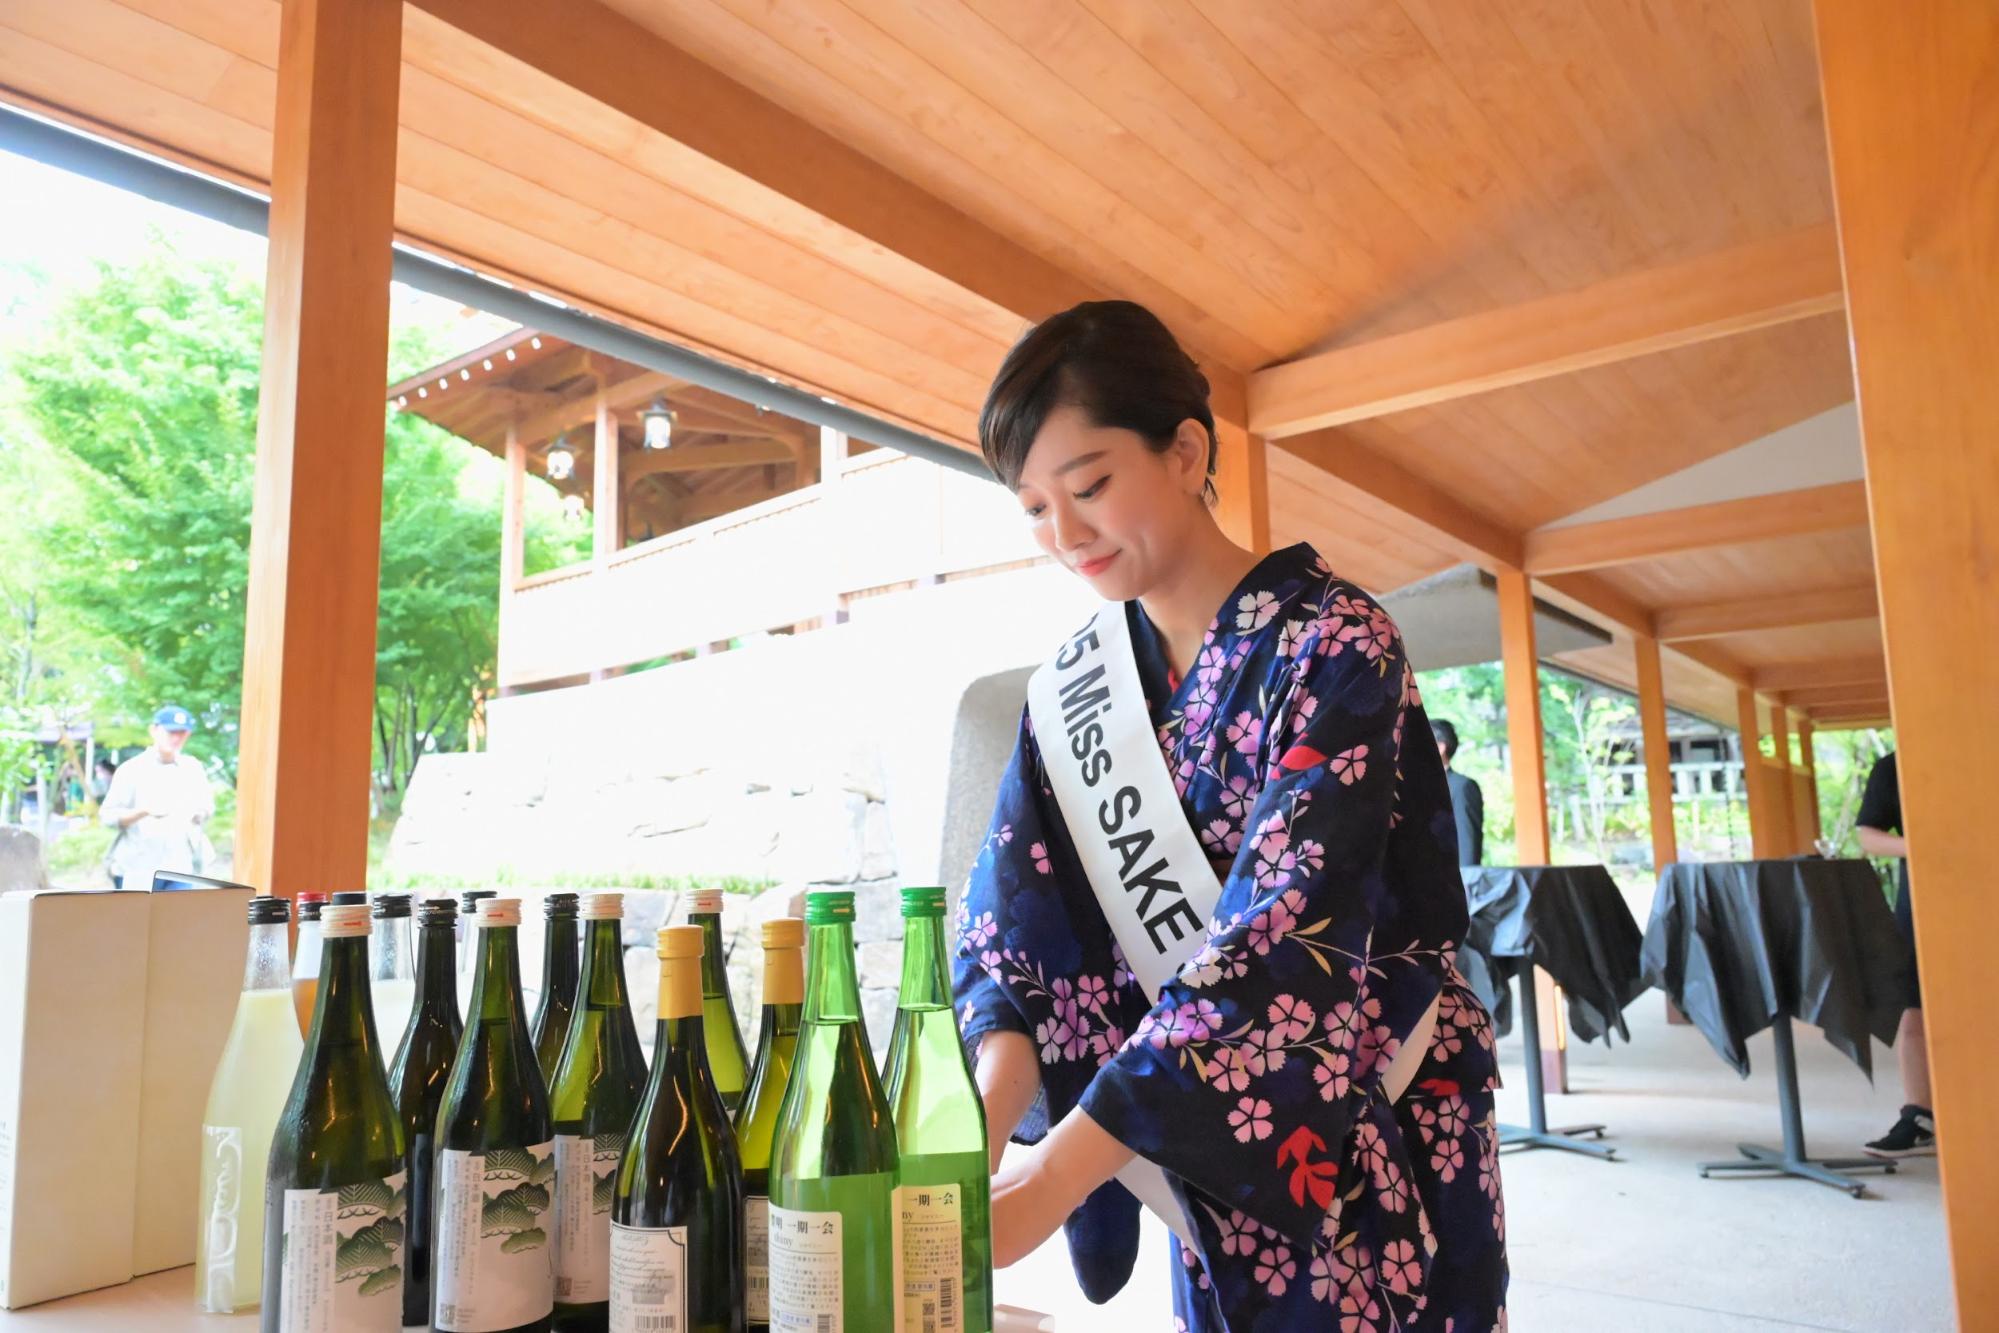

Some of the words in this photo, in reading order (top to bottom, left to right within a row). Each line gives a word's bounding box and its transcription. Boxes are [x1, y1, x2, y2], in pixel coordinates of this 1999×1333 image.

[1058, 663, 1112, 787] Miss
[1098, 786, 1205, 955] SAKE
[907, 1192, 954, 1207] 一期一会
[787, 1220, 834, 1235] 一期一会
